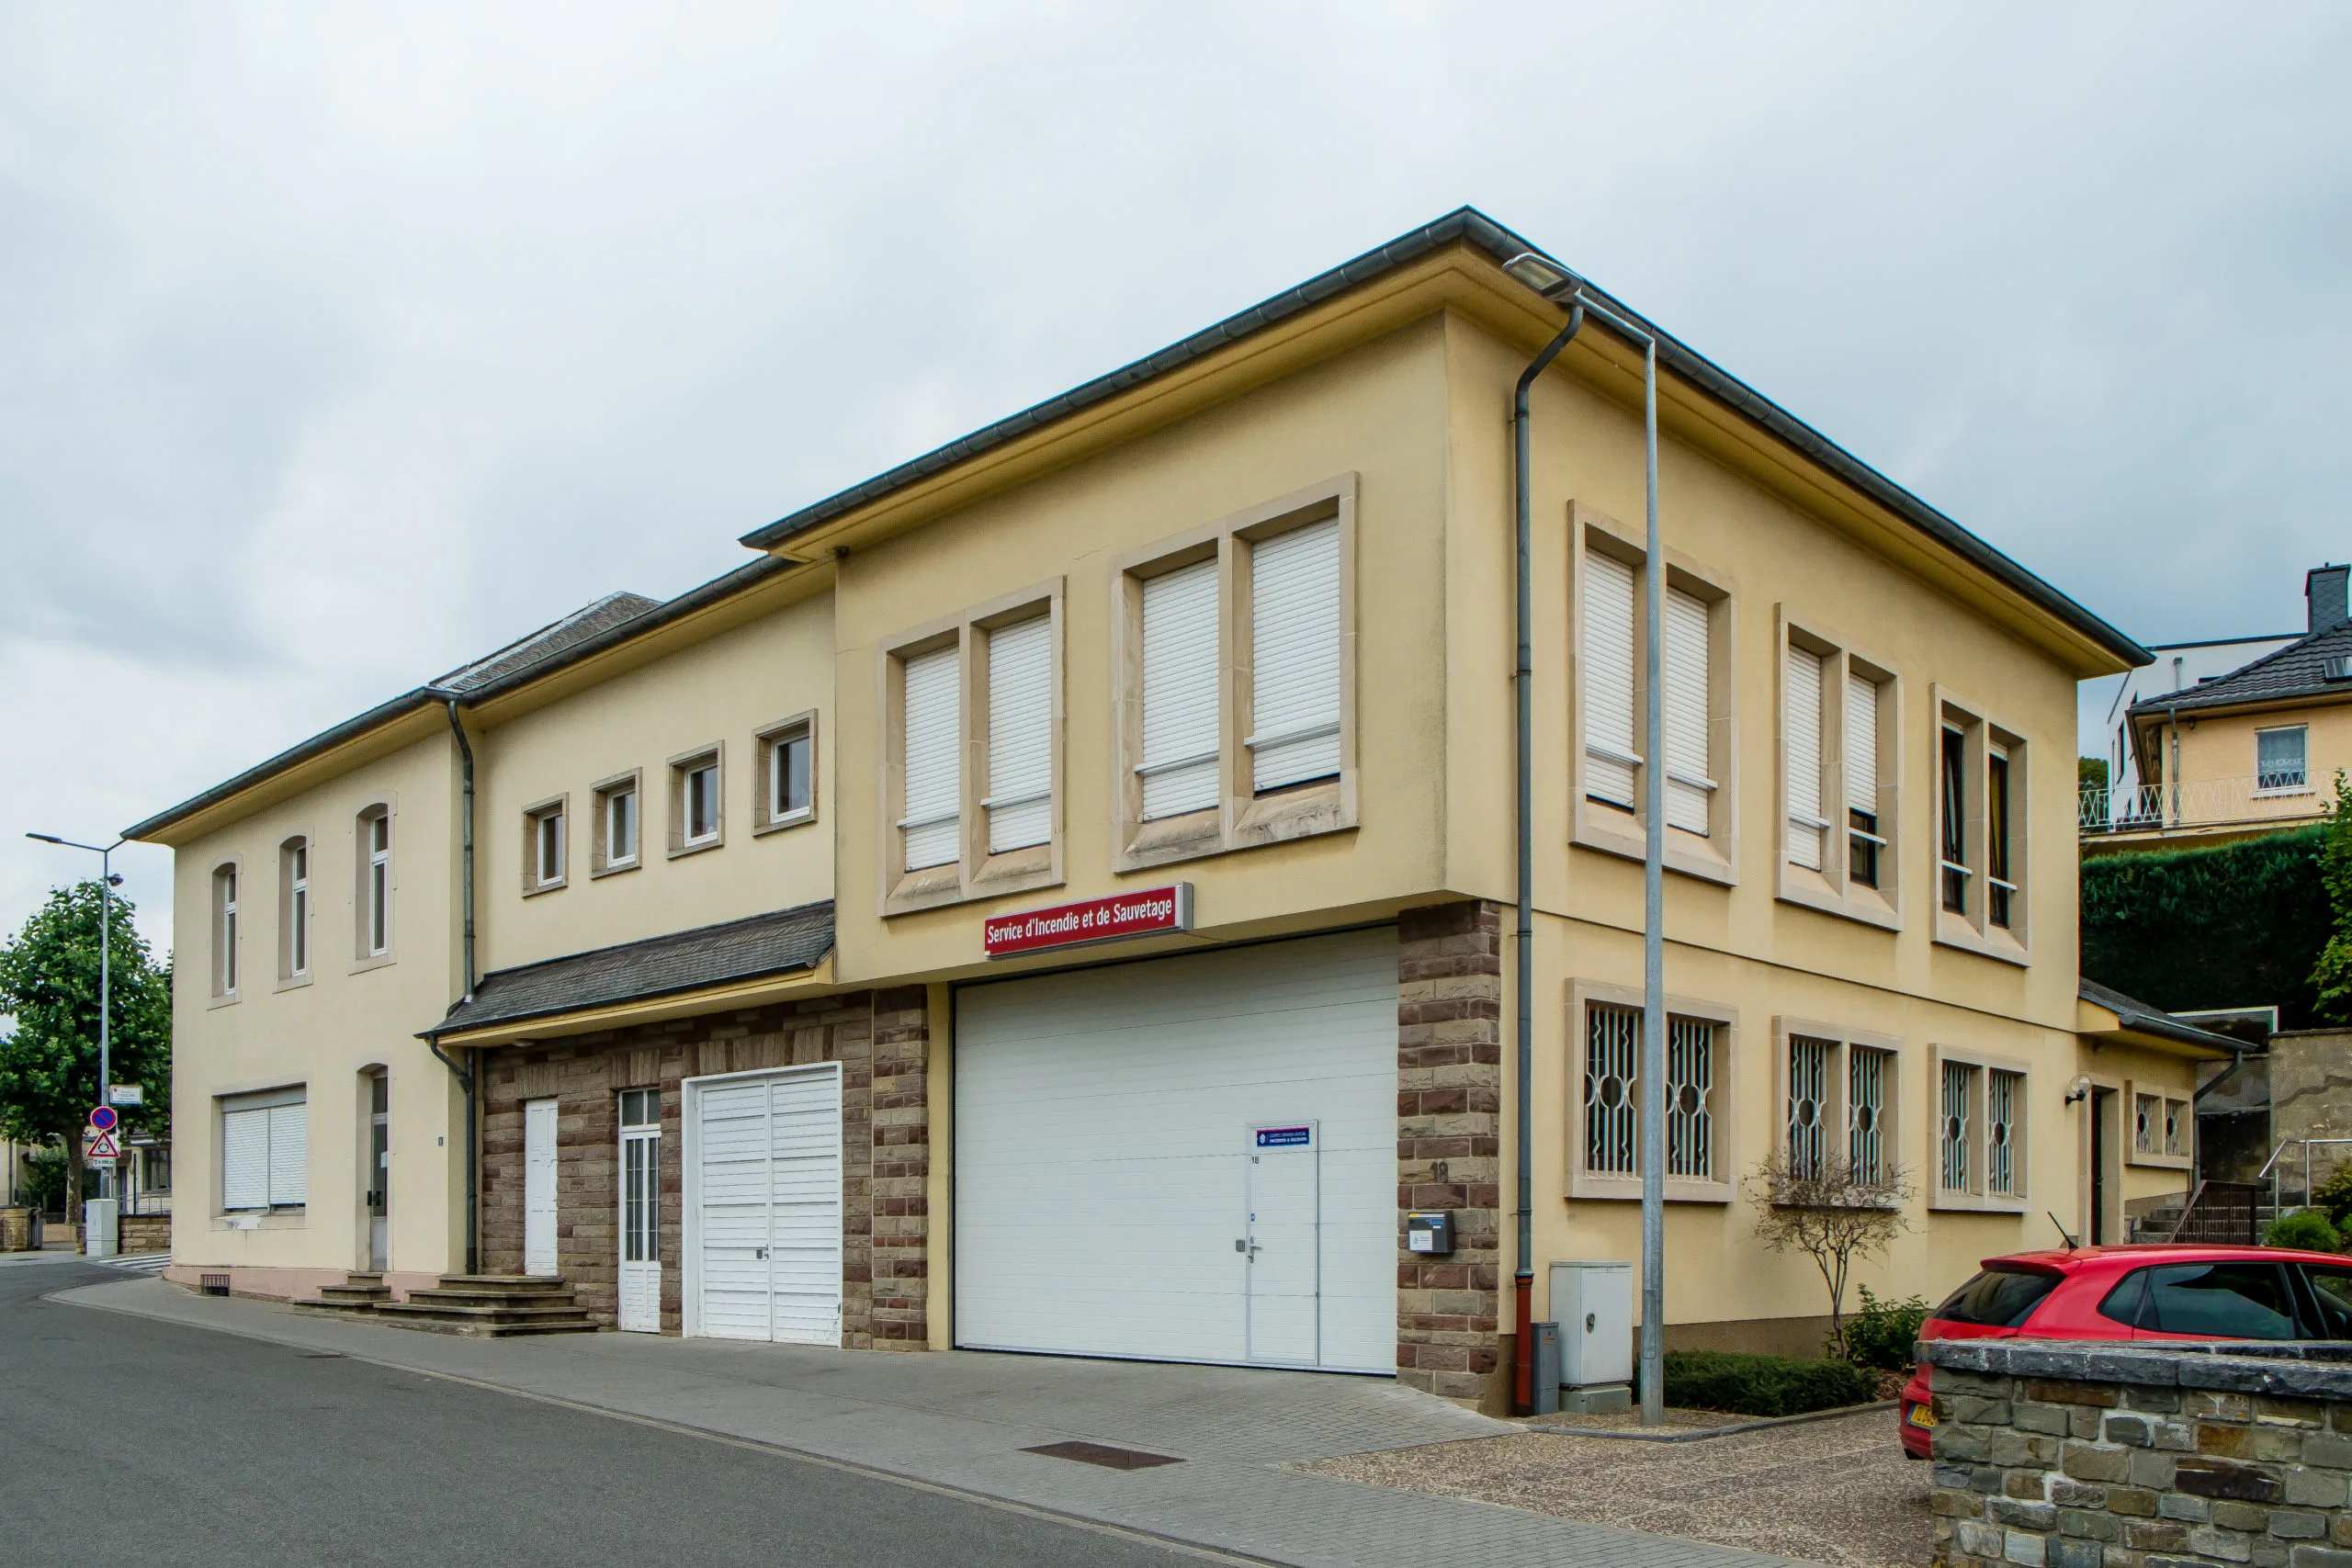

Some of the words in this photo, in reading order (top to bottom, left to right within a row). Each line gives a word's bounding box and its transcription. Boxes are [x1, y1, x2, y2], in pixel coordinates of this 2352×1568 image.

[988, 922, 1023, 943] Service
[1025, 912, 1079, 937] d'Incendie
[1082, 909, 1094, 928] et
[1096, 907, 1110, 926] de
[1114, 898, 1172, 923] Sauvetage
[1430, 1161, 1448, 1183] 18
